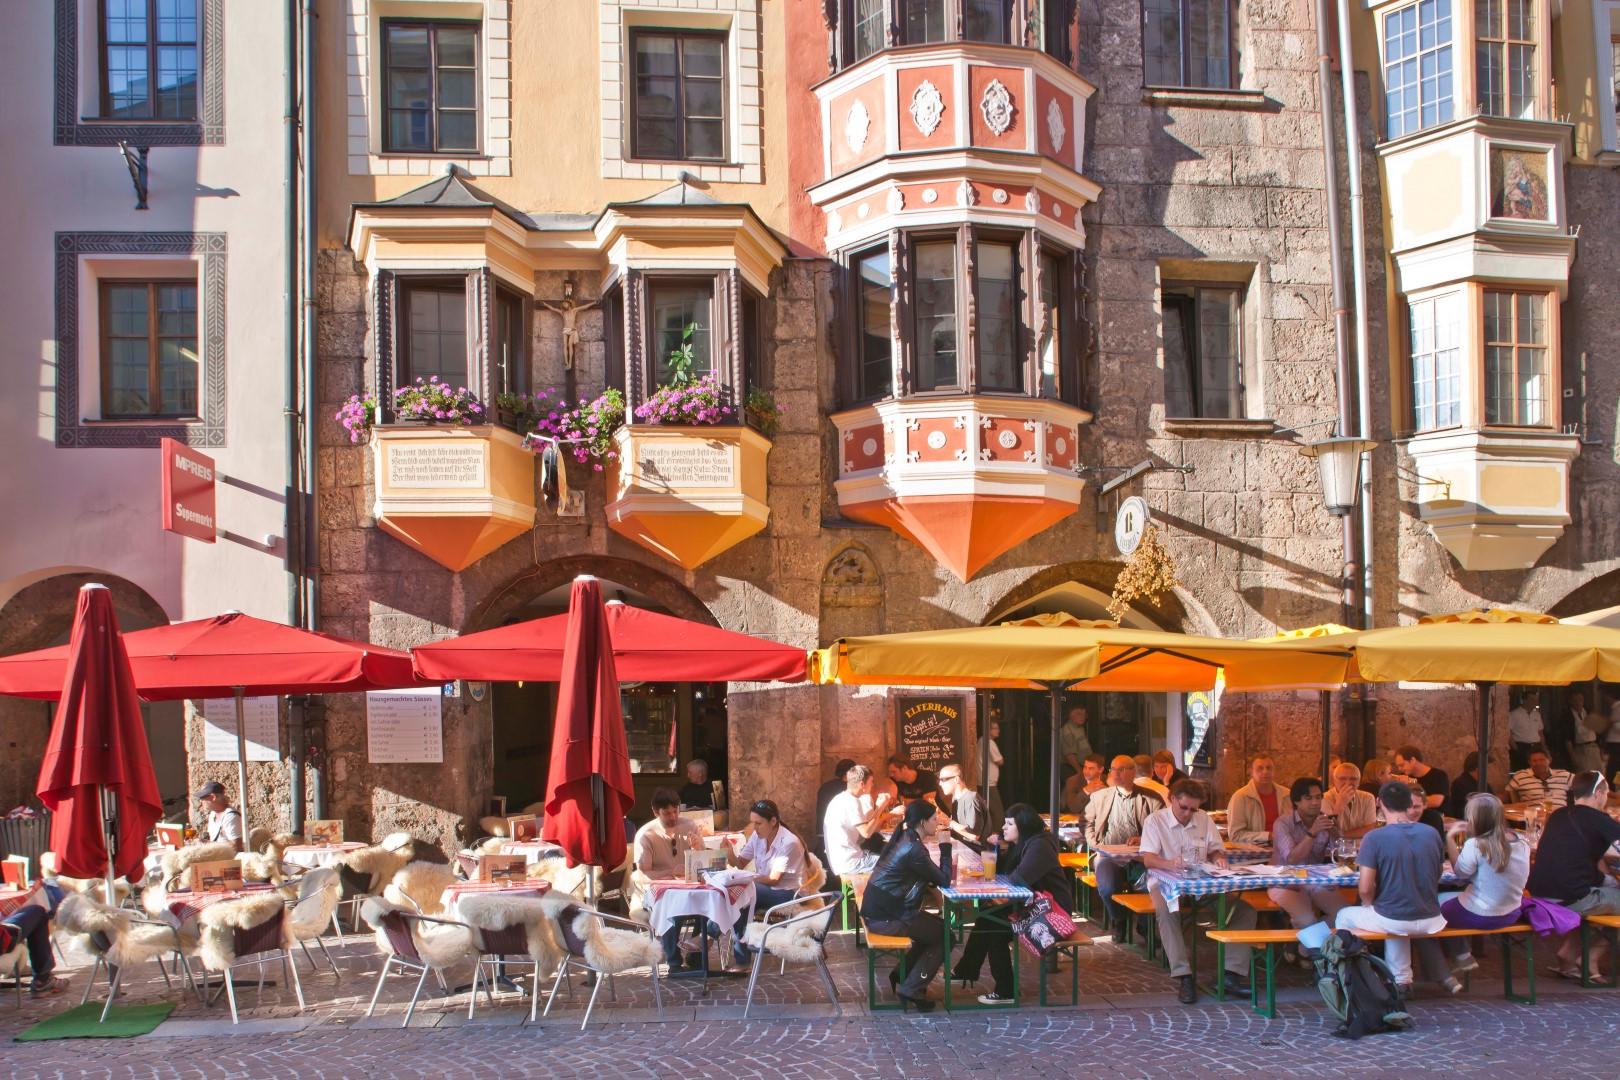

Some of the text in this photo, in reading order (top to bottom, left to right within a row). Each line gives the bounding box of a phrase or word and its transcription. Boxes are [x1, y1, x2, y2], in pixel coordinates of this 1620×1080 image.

[175, 453, 212, 481] MPREIS
[176, 502, 212, 528] Supermarkt
[904, 702, 958, 719] ELFERHAUS
